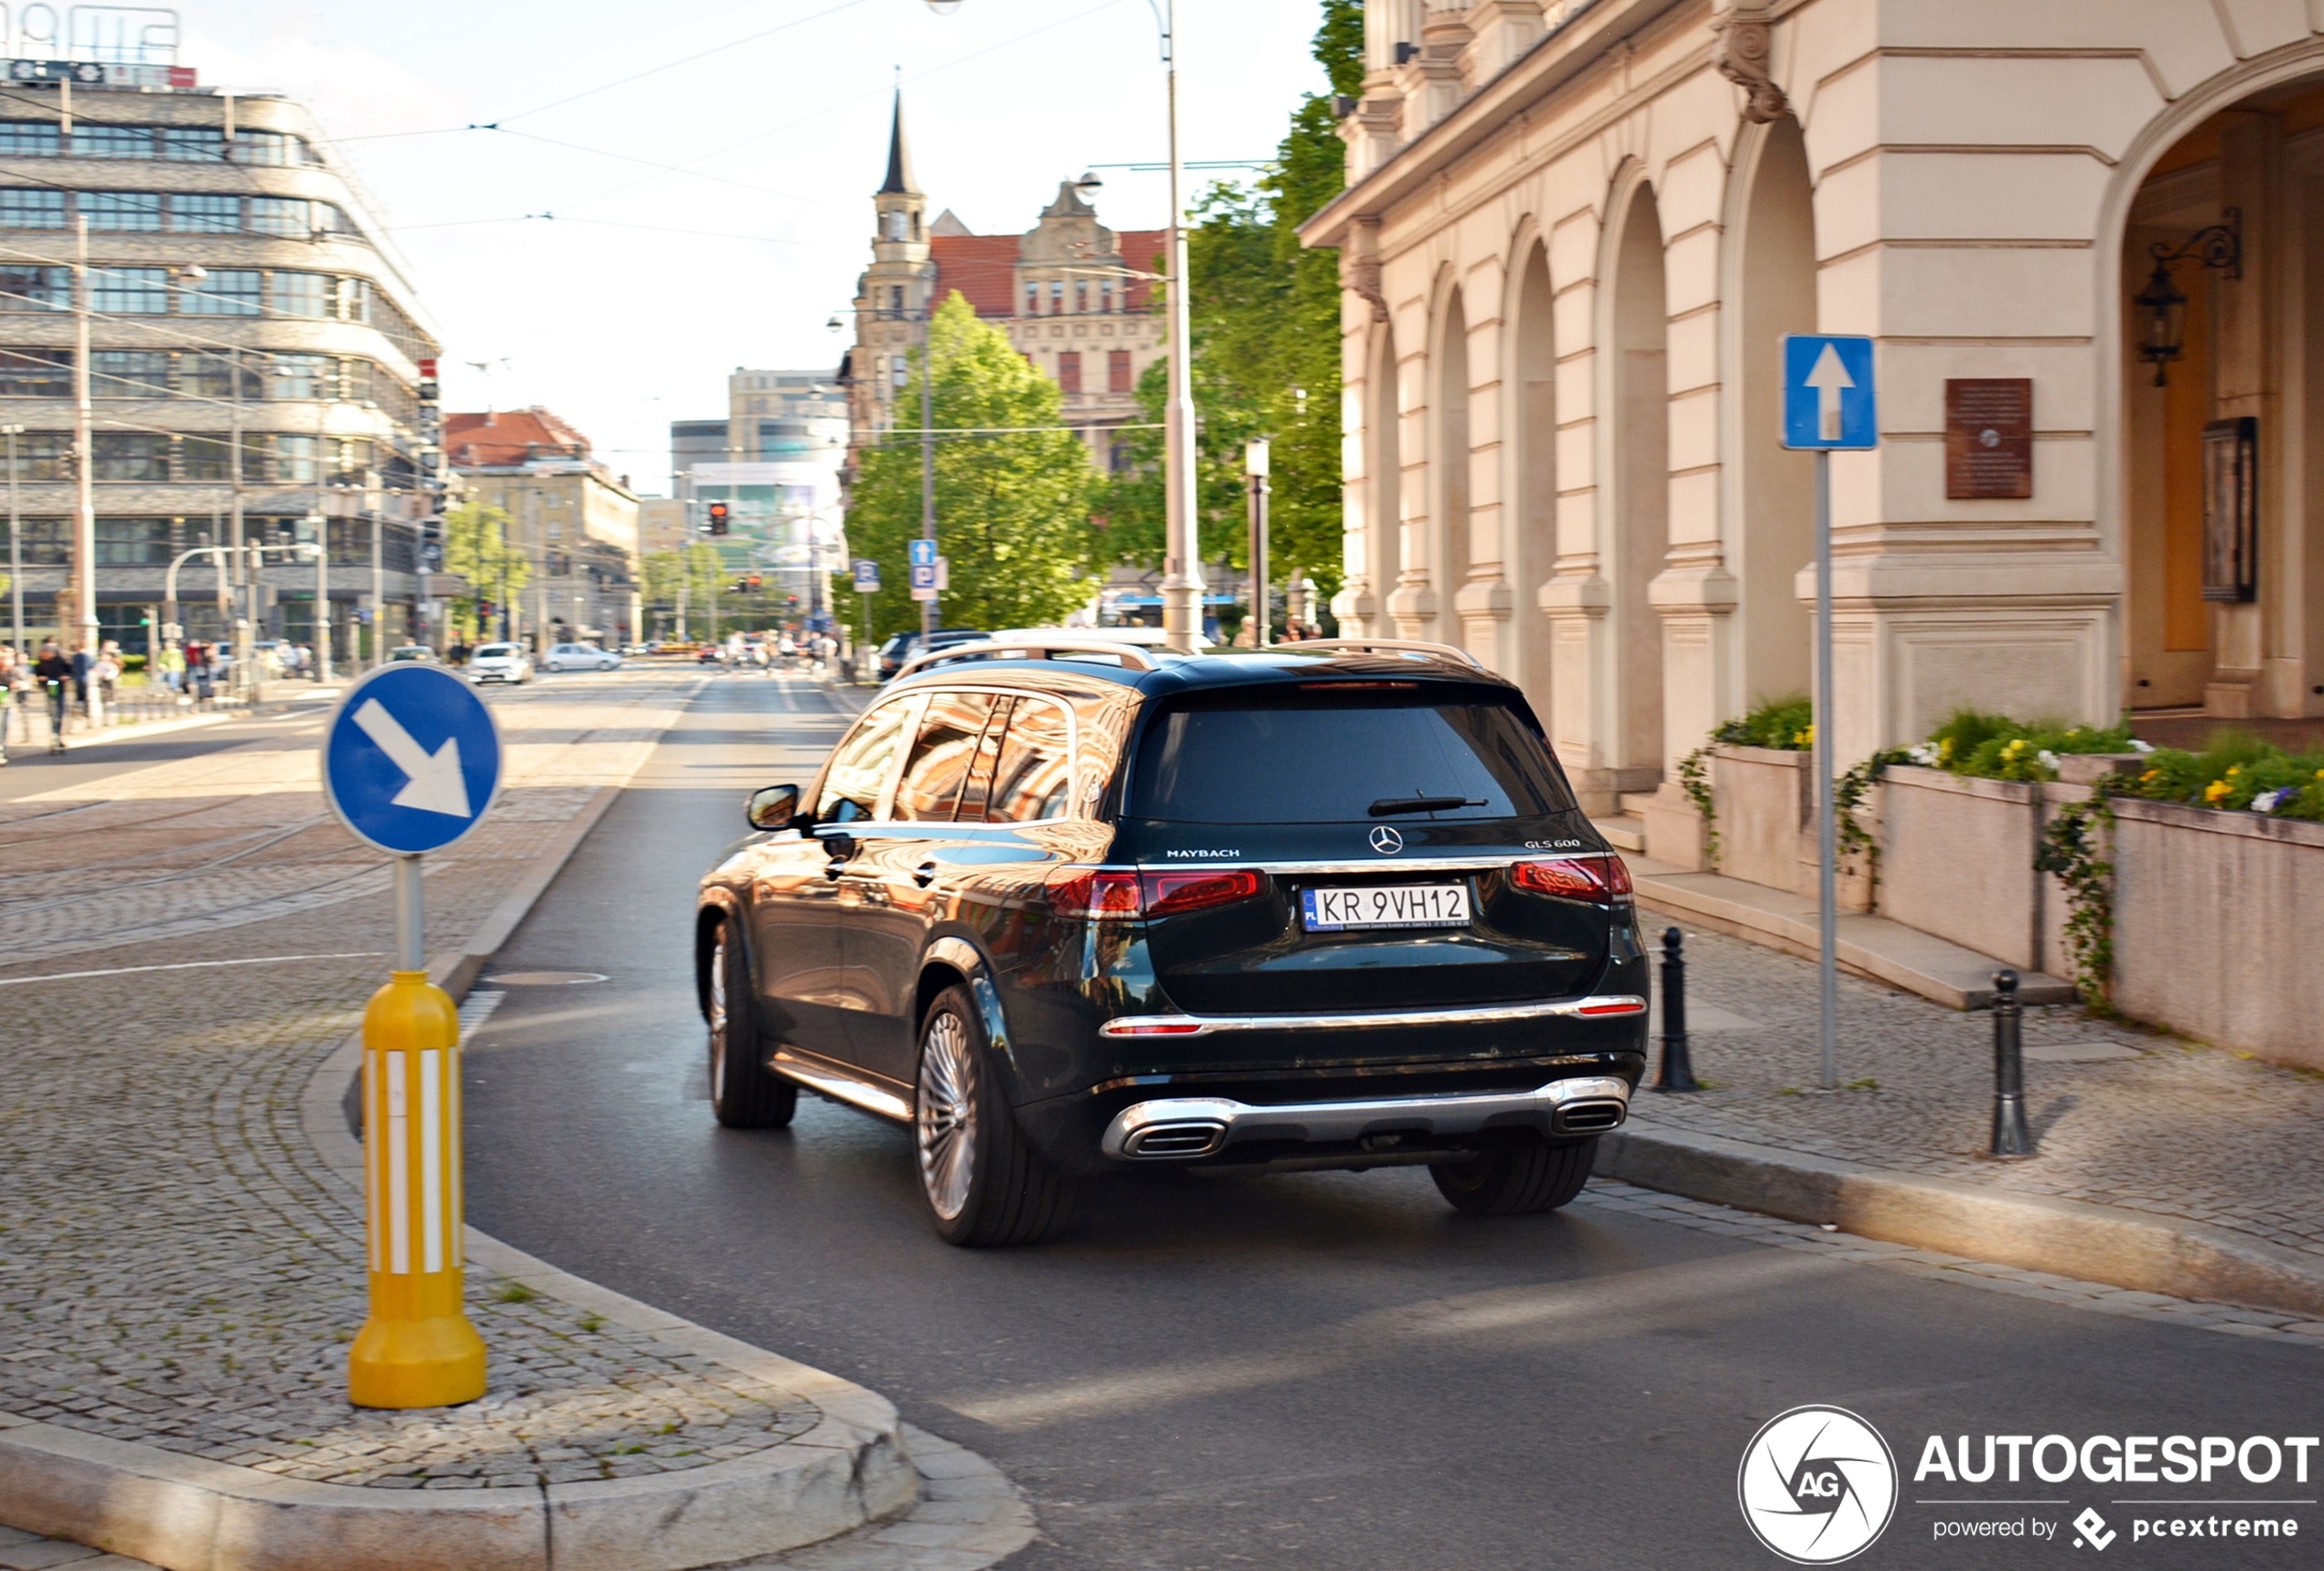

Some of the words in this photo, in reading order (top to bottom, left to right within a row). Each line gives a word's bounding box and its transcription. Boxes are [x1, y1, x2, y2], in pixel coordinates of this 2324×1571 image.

[1524, 840, 1552, 849] GLS
[1554, 838, 1581, 848] 600
[1167, 849, 1240, 857] MAYBACH
[1323, 892, 1361, 921] KR
[1372, 889, 1462, 920] 9VH12
[1305, 911, 1317, 920] PL
